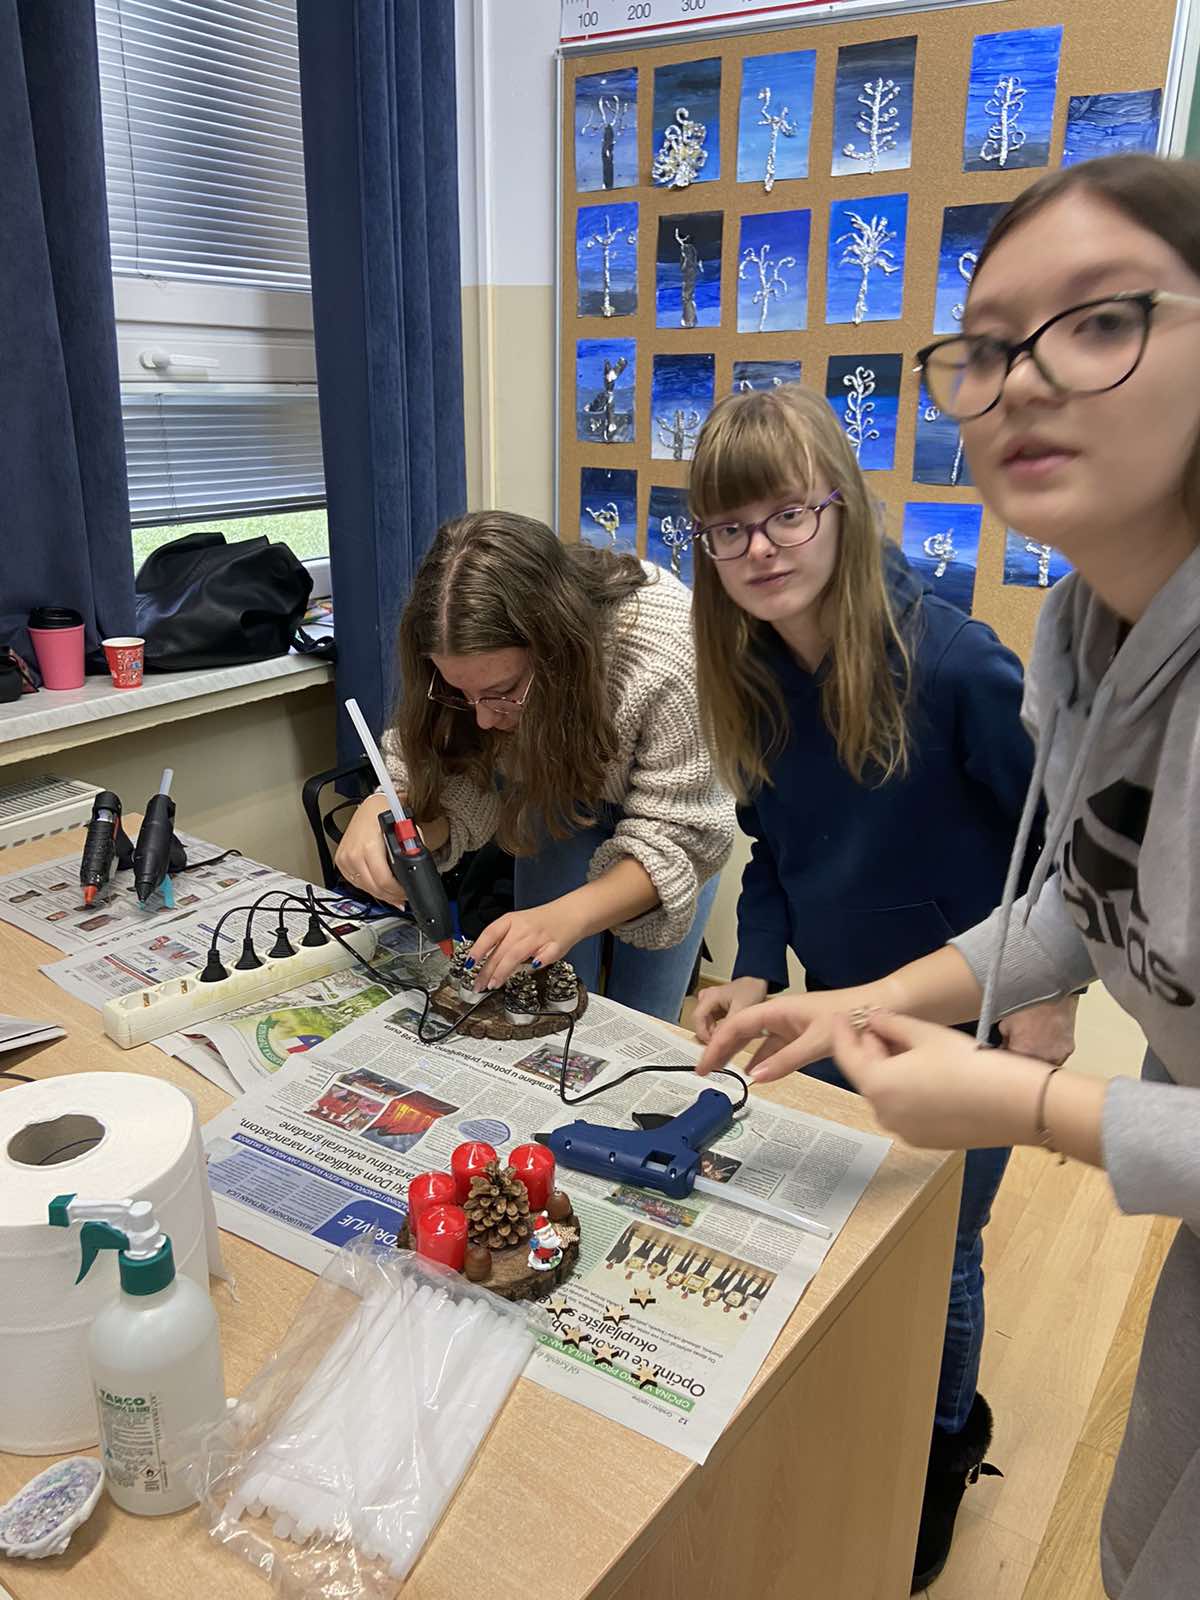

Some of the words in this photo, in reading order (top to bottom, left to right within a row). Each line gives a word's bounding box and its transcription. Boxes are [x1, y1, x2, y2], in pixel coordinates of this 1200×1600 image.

[578, 11, 599, 29] 100
[627, 2, 651, 20] 200
[681, 0, 706, 12] 300
[383, 1024, 402, 1034] eura
[238, 1119, 306, 1153] narančastom,
[319, 1138, 366, 1164] educirali
[313, 1151, 364, 1178] sindikata
[365, 1156, 416, 1184] araždinu
[362, 1171, 392, 1189] Dom
[576, 1310, 659, 1355] okupljalište
[618, 1370, 654, 1391] VIOKO
[677, 1417, 688, 1425] 12
